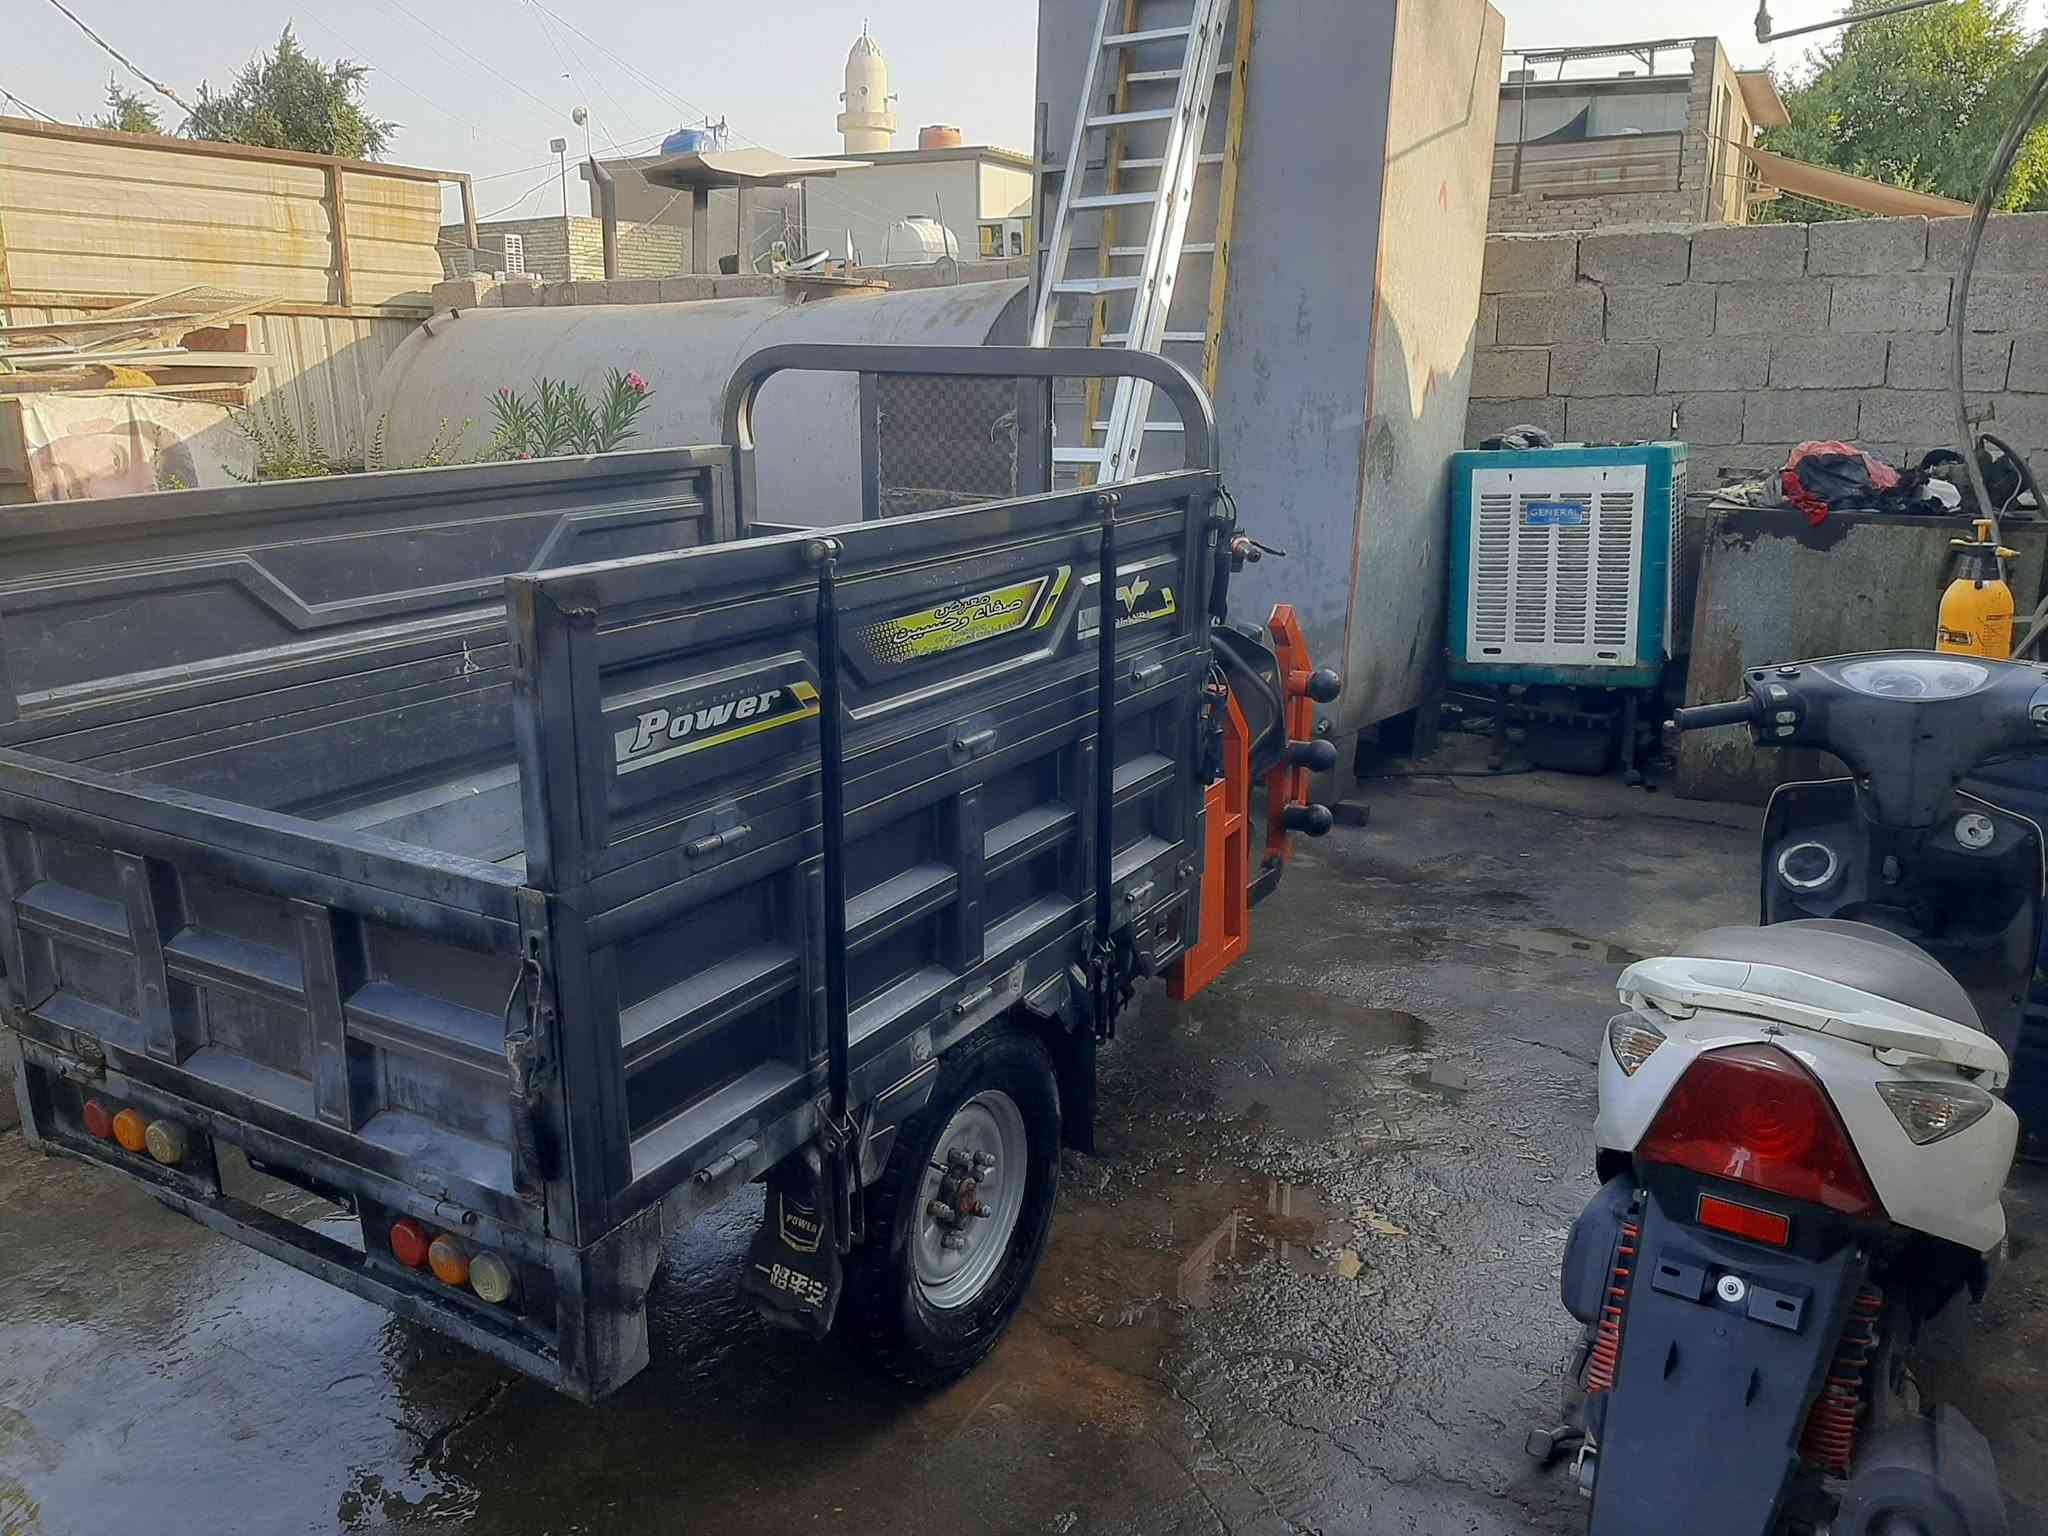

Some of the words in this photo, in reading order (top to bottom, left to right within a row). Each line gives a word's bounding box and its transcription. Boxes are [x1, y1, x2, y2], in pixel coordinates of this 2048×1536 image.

[934, 594, 992, 619] معرض
[973, 598, 1024, 621] صفاء
[893, 615, 970, 643] وحسين
[630, 689, 781, 753] Power
[786, 1214, 817, 1233] POWER
